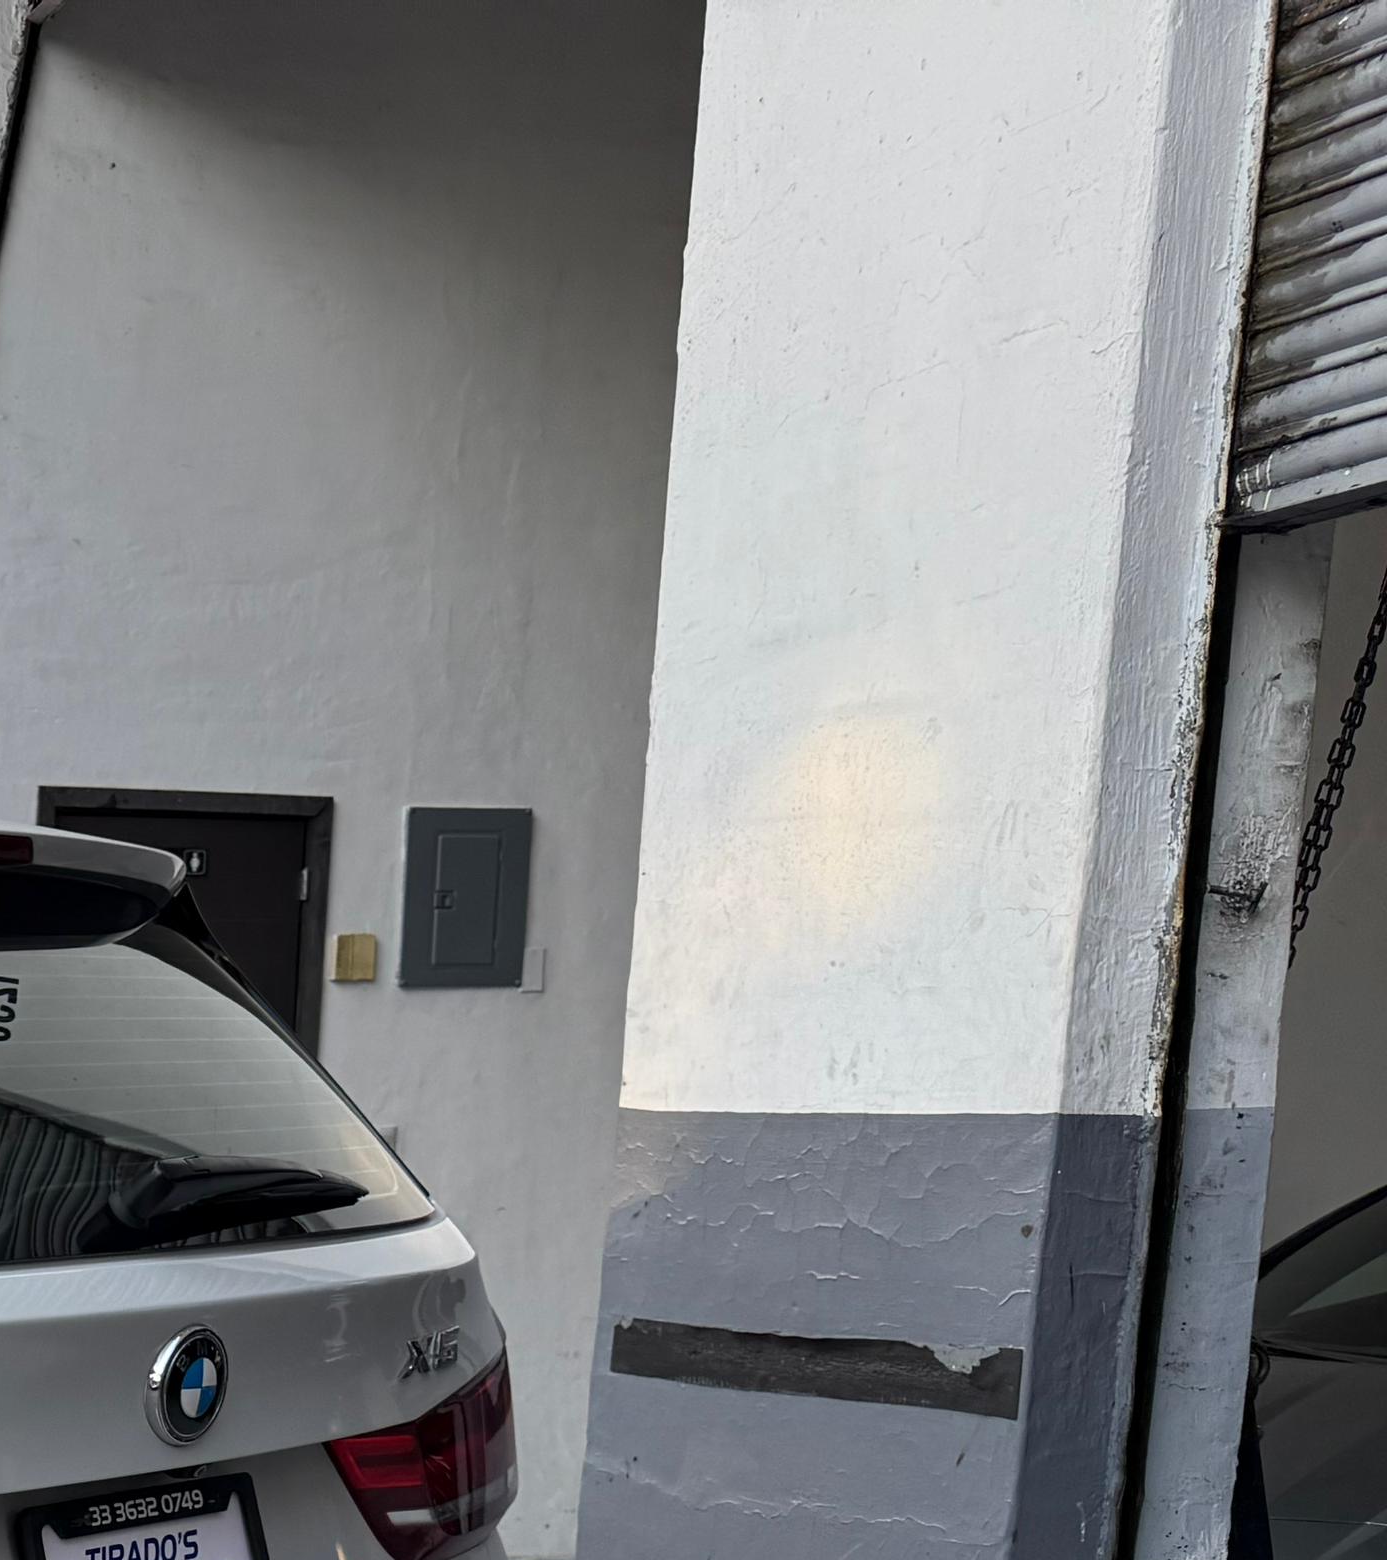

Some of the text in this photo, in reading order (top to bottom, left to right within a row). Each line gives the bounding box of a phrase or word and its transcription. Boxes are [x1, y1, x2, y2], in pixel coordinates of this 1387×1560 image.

[396, 1325, 460, 1379] X5
[88, 1488, 204, 1527] 33 3632 0749
